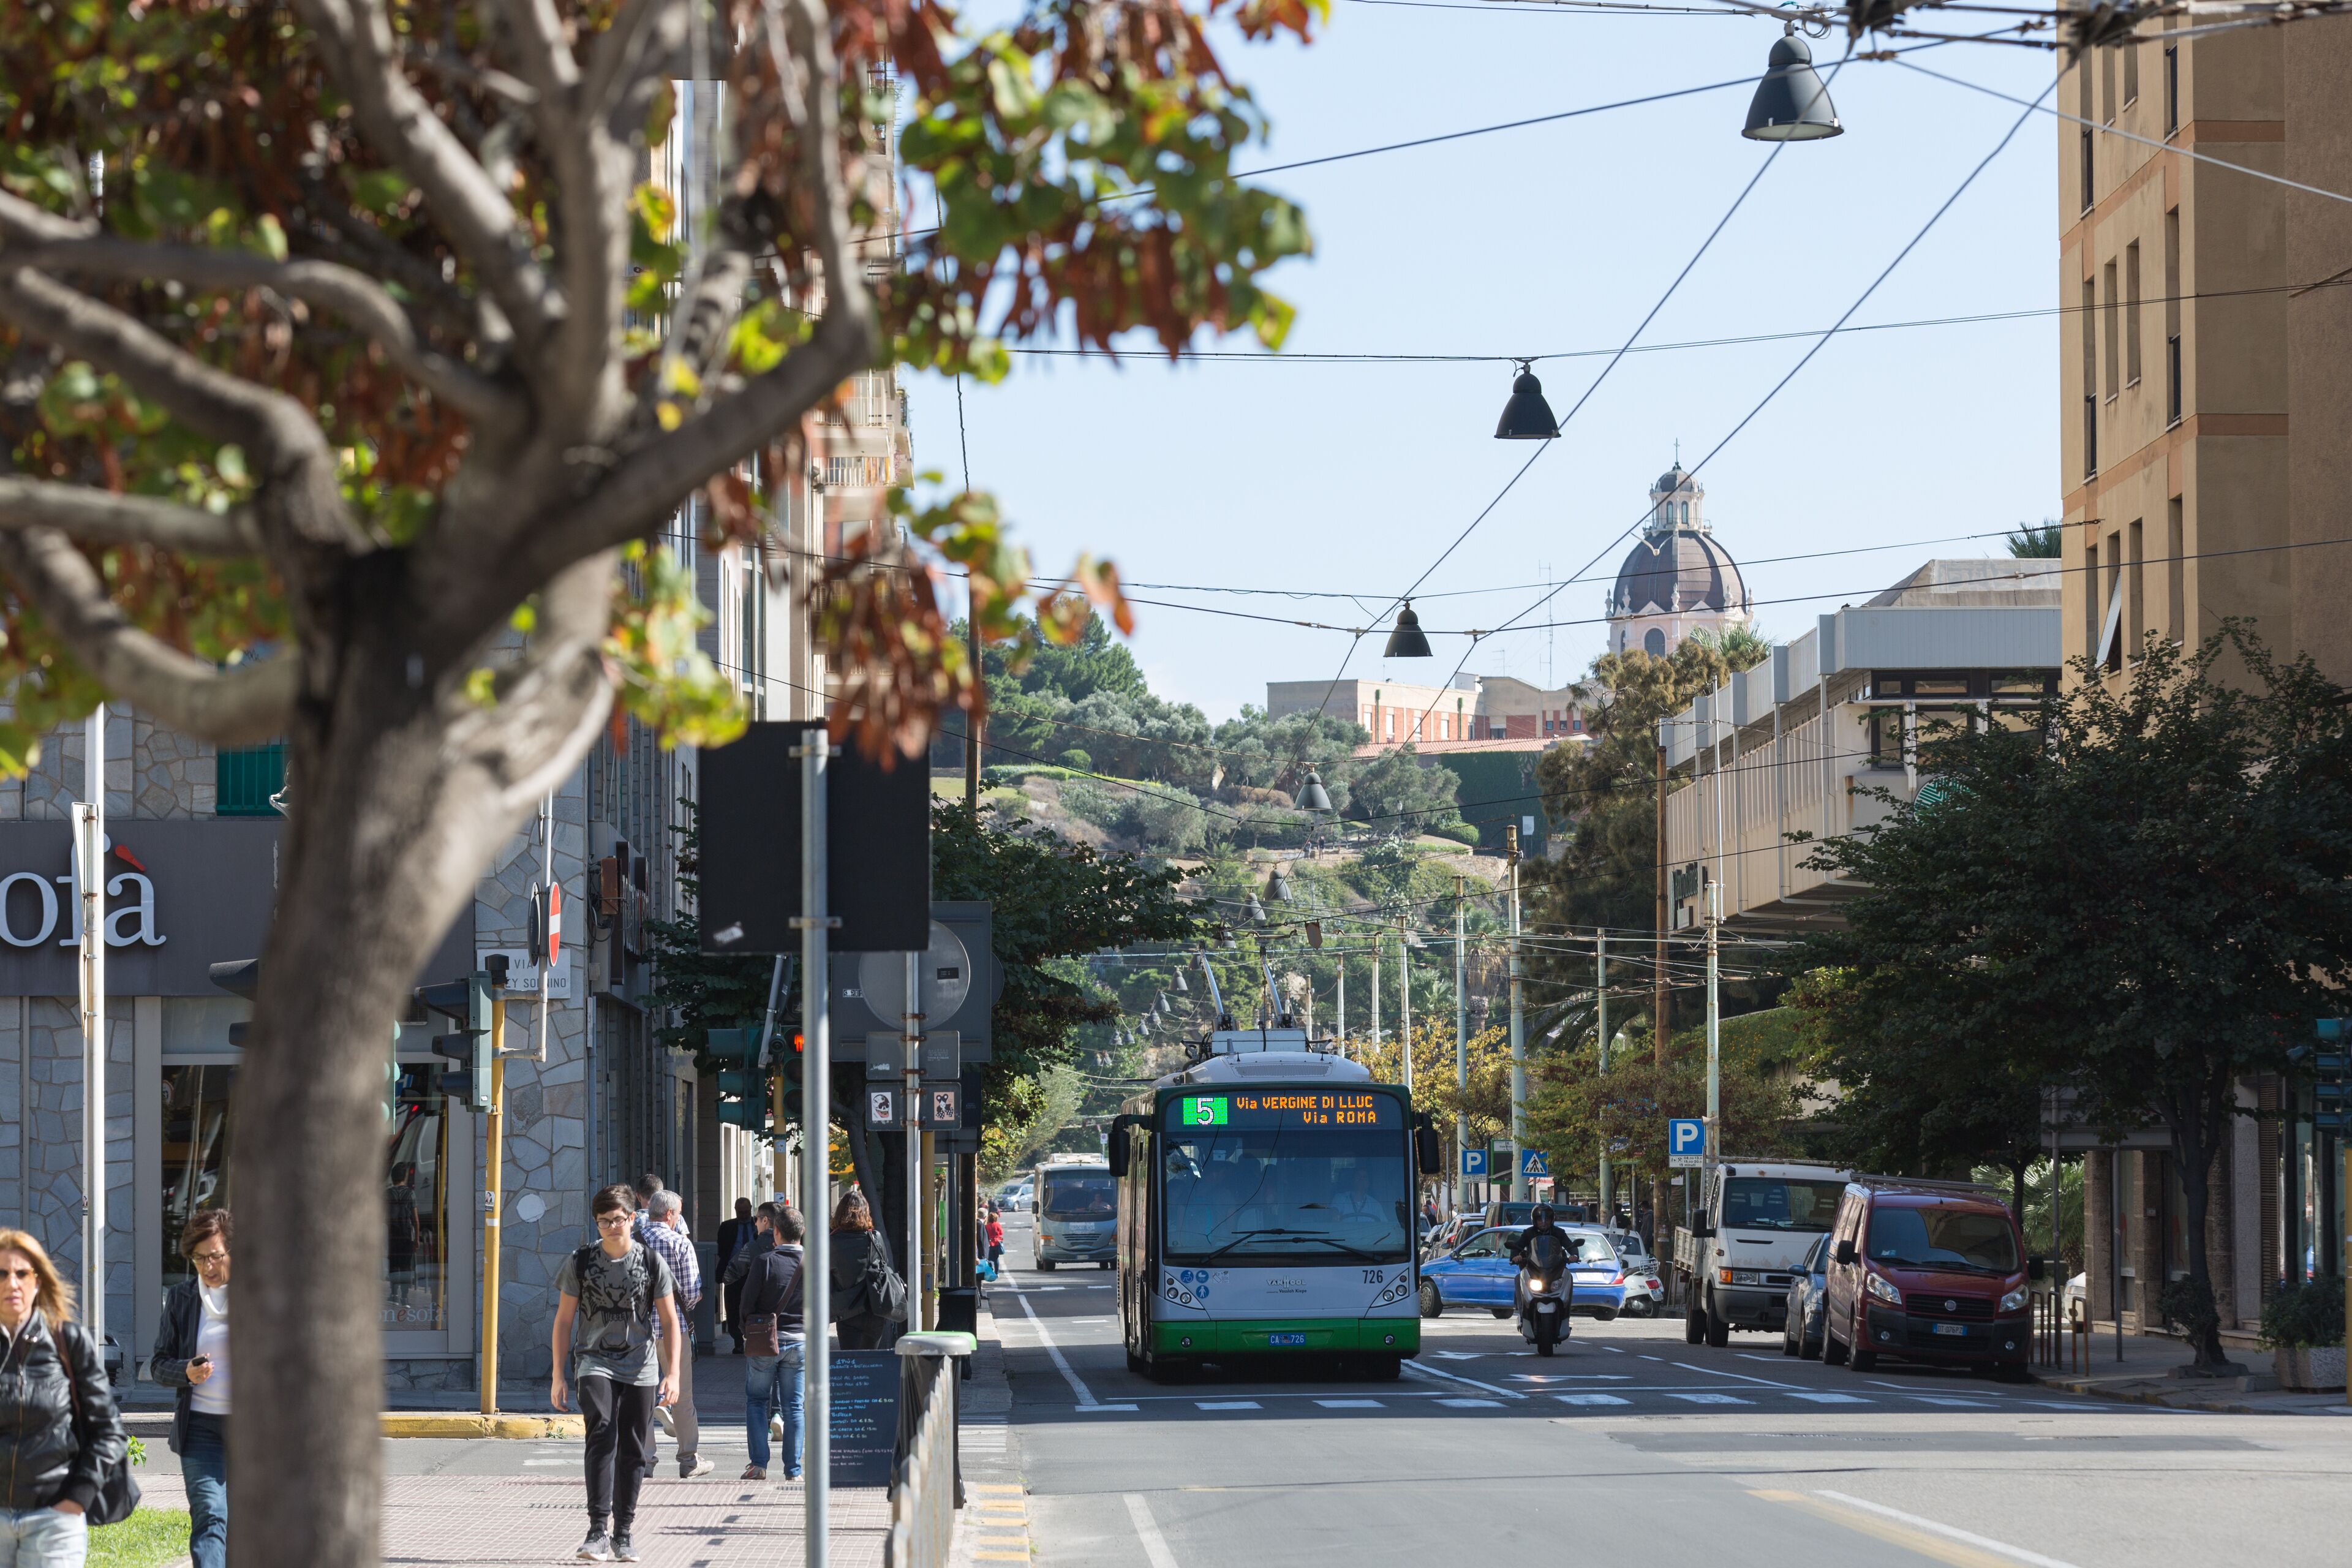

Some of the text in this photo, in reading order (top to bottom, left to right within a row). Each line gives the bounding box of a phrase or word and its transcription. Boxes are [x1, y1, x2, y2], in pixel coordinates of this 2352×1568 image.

[514, 959, 533, 969] VIA
[1237, 1096, 1373, 1109] Via VERGINE DI LLUC
[1196, 1097, 1215, 1125] 5
[1303, 1111, 1377, 1124] Via ROMA
[1676, 1123, 1698, 1152] P
[1466, 1152, 1482, 1172] P
[1362, 1270, 1383, 1284] 726
[1270, 1335, 1305, 1344] CA 726
